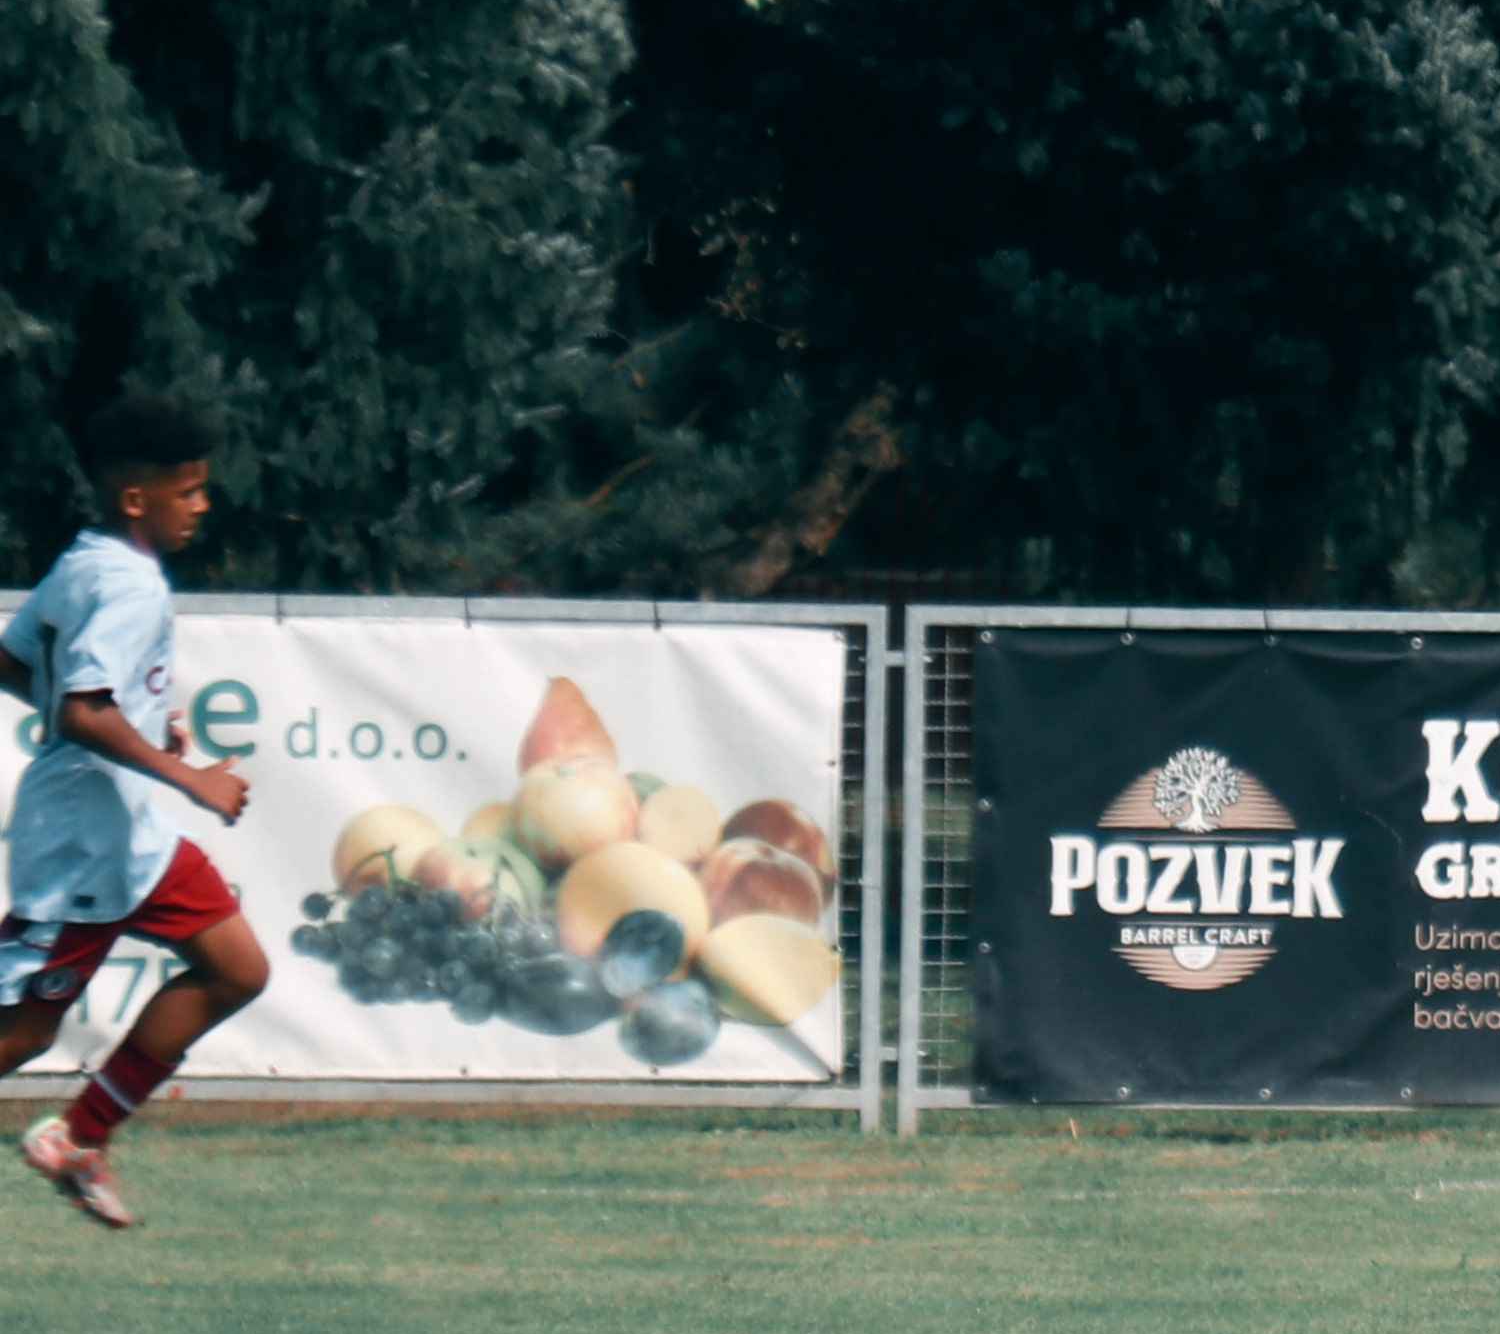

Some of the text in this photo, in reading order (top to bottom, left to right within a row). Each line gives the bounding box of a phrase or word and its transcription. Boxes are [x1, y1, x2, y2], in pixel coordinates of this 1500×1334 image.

[286, 707, 467, 761] d.o.o.
[1050, 835, 1345, 918] POZVEK
[1120, 927, 1272, 945] BARREL CRAFT
